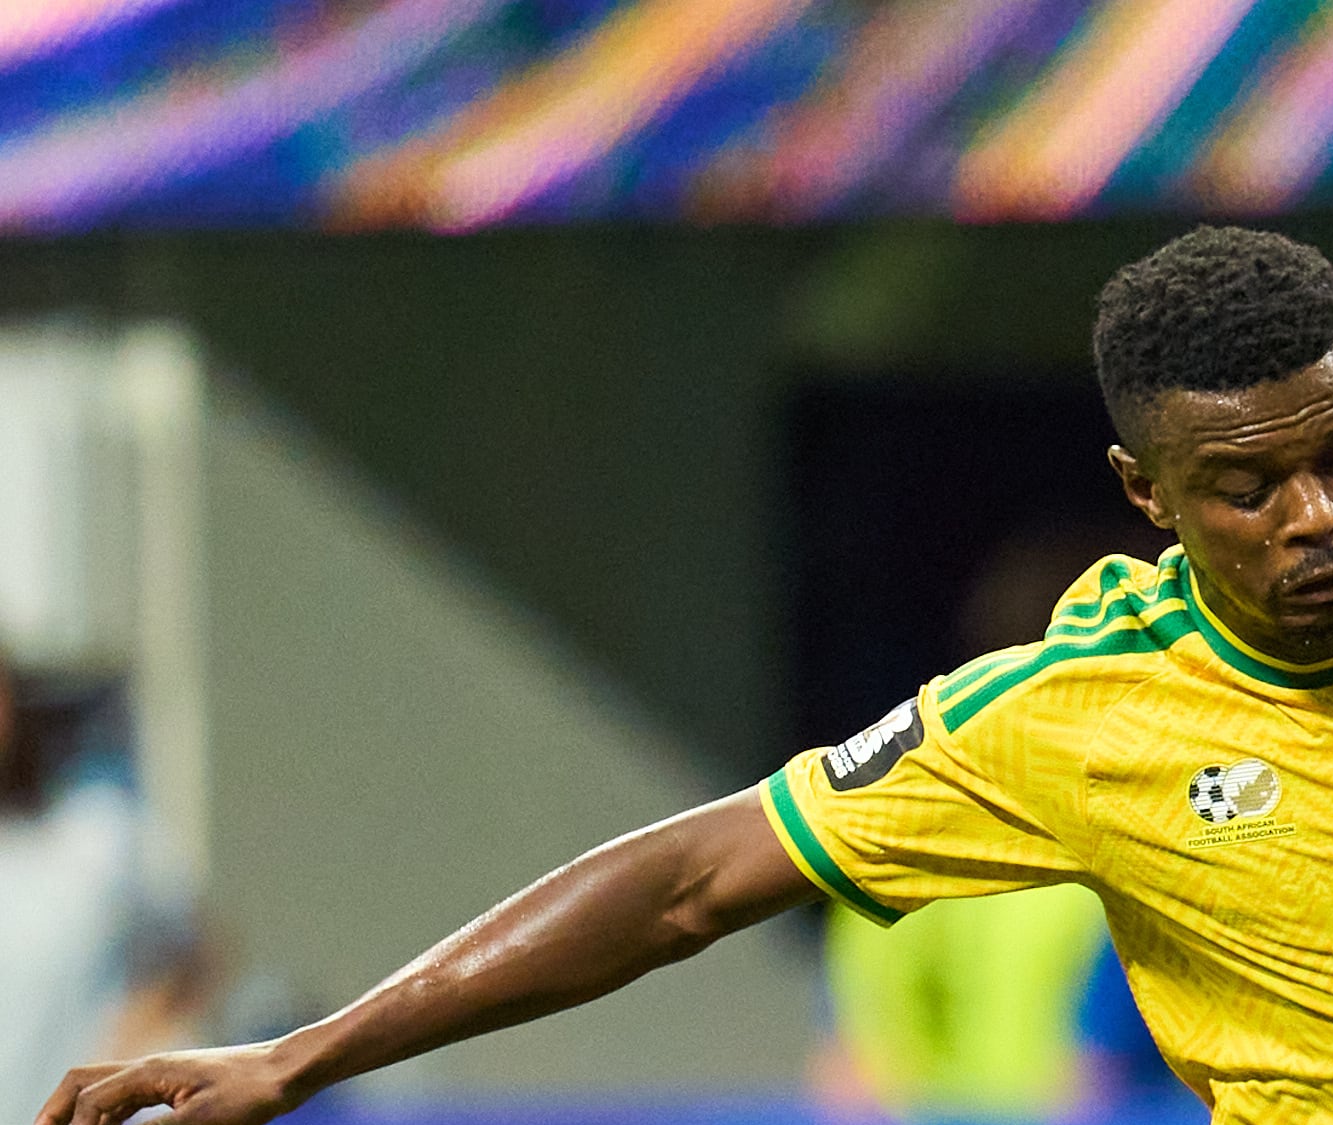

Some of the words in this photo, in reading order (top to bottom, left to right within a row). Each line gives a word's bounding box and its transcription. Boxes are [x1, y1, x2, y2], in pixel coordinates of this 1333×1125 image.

[1188, 835, 1234, 847] FOOTBALL
[1235, 826, 1295, 841] ASSOCIATION
[1205, 825, 1234, 836] SOUTH
[1236, 819, 1276, 831] AFRICAN
